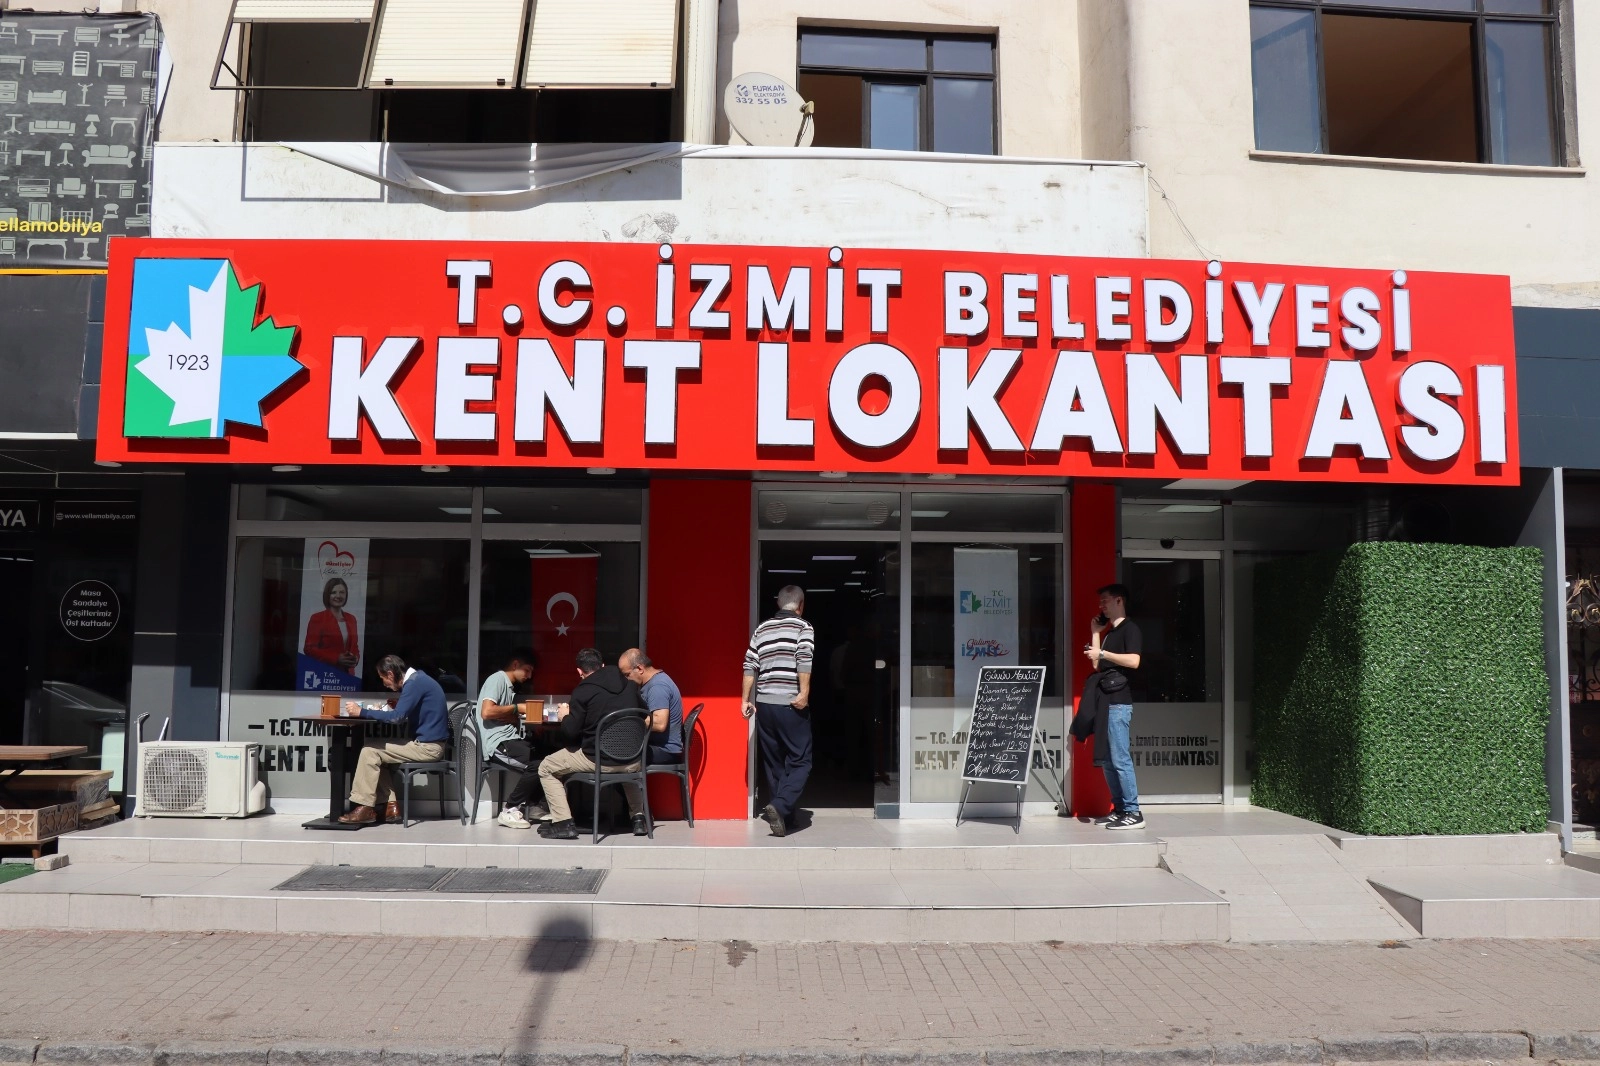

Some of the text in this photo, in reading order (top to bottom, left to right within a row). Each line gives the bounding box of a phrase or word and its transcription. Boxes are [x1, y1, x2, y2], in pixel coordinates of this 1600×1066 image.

[773, 97, 788, 105] 05
[445, 243, 1413, 352] T.C. İZMİT BELEDİYESİ
[167, 354, 210, 371] 1923
[327, 335, 1507, 464] KENT LOKANTASI
[0, 509, 27, 527] YA
[64, 512, 136, 521] www.vellamobilya.com
[80, 589, 102, 597] Masa
[72, 599, 108, 608] Sandalye
[65, 618, 79, 627] Üst
[269, 719, 294, 736] T.C.
[929, 732, 949, 745] T.C.
[1135, 734, 1160, 747] İZMİT
[1161, 734, 1208, 747] BELEDİYESİ
[914, 750, 960, 770] KENT
[1145, 750, 1219, 767] LOKANTASI
